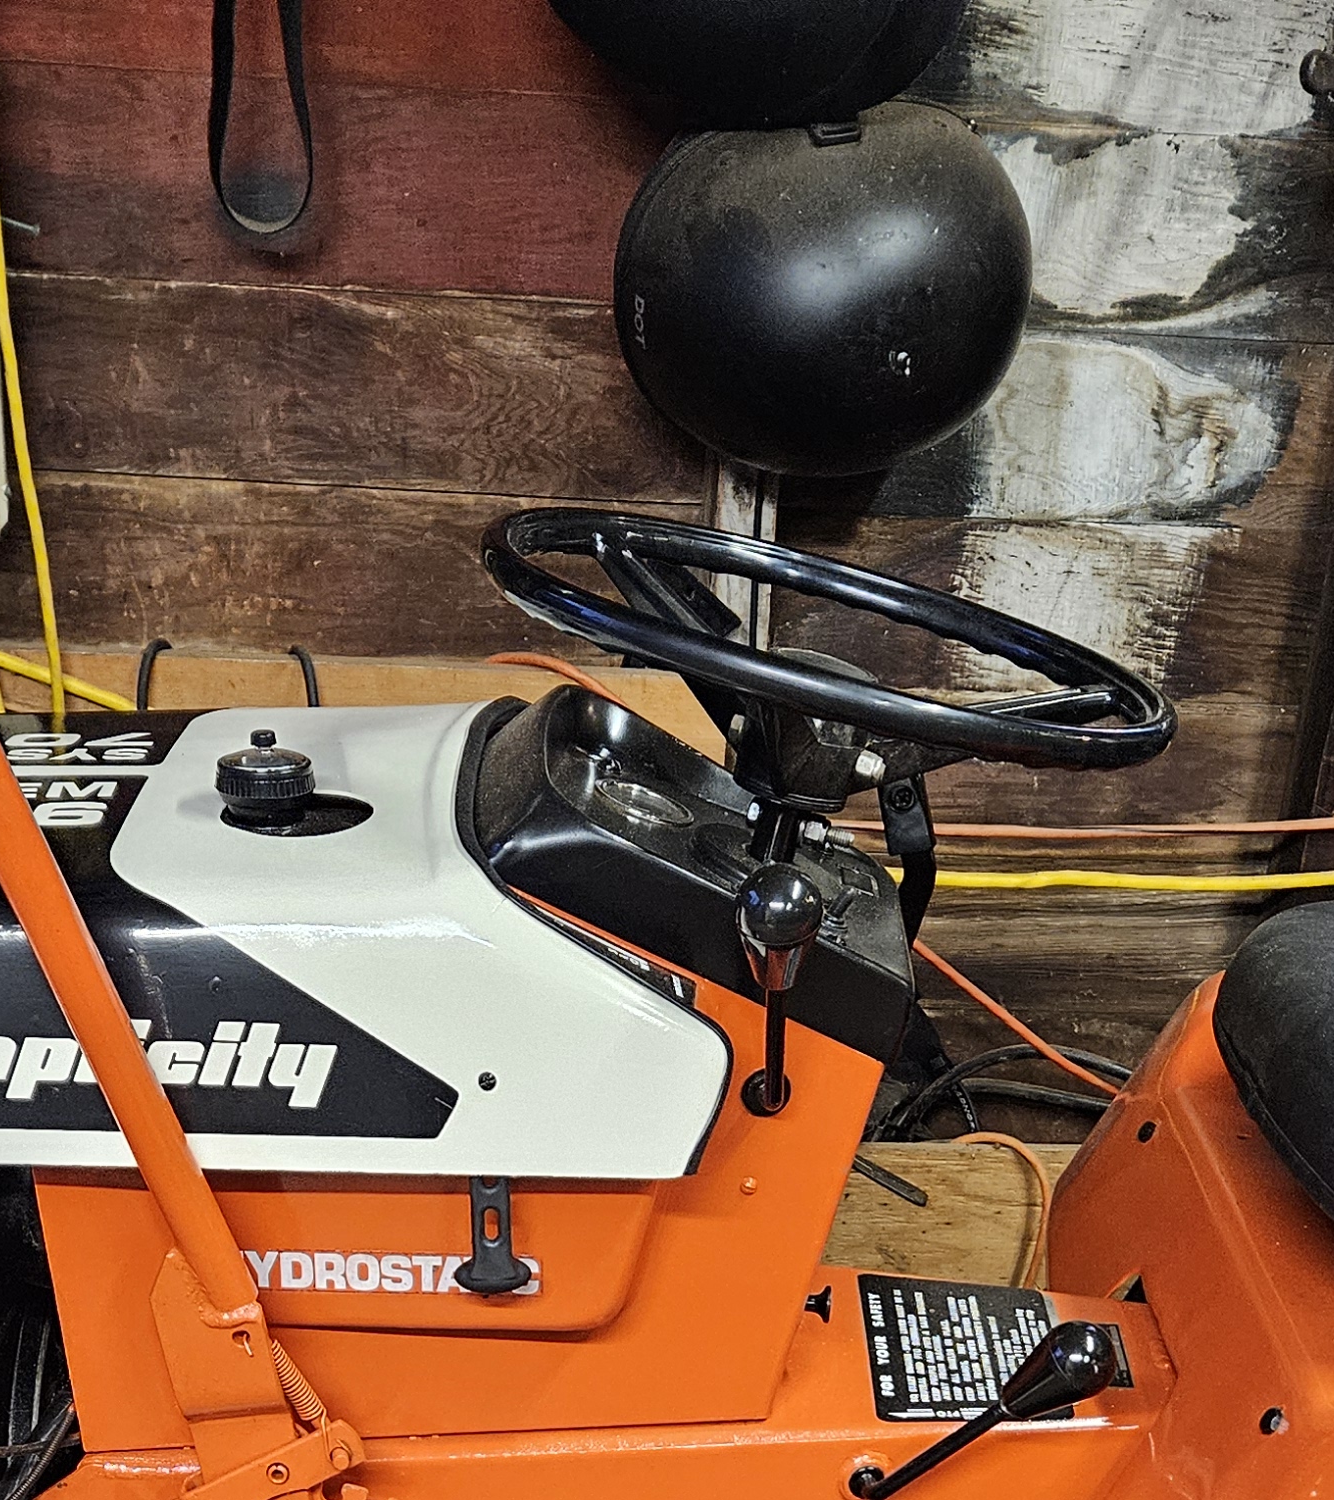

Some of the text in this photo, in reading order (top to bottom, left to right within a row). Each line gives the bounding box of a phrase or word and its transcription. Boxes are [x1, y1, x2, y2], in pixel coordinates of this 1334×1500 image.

[634, 294, 646, 350] DOT
[867, 1292, 896, 1397] FOR YOUR SAFETY
